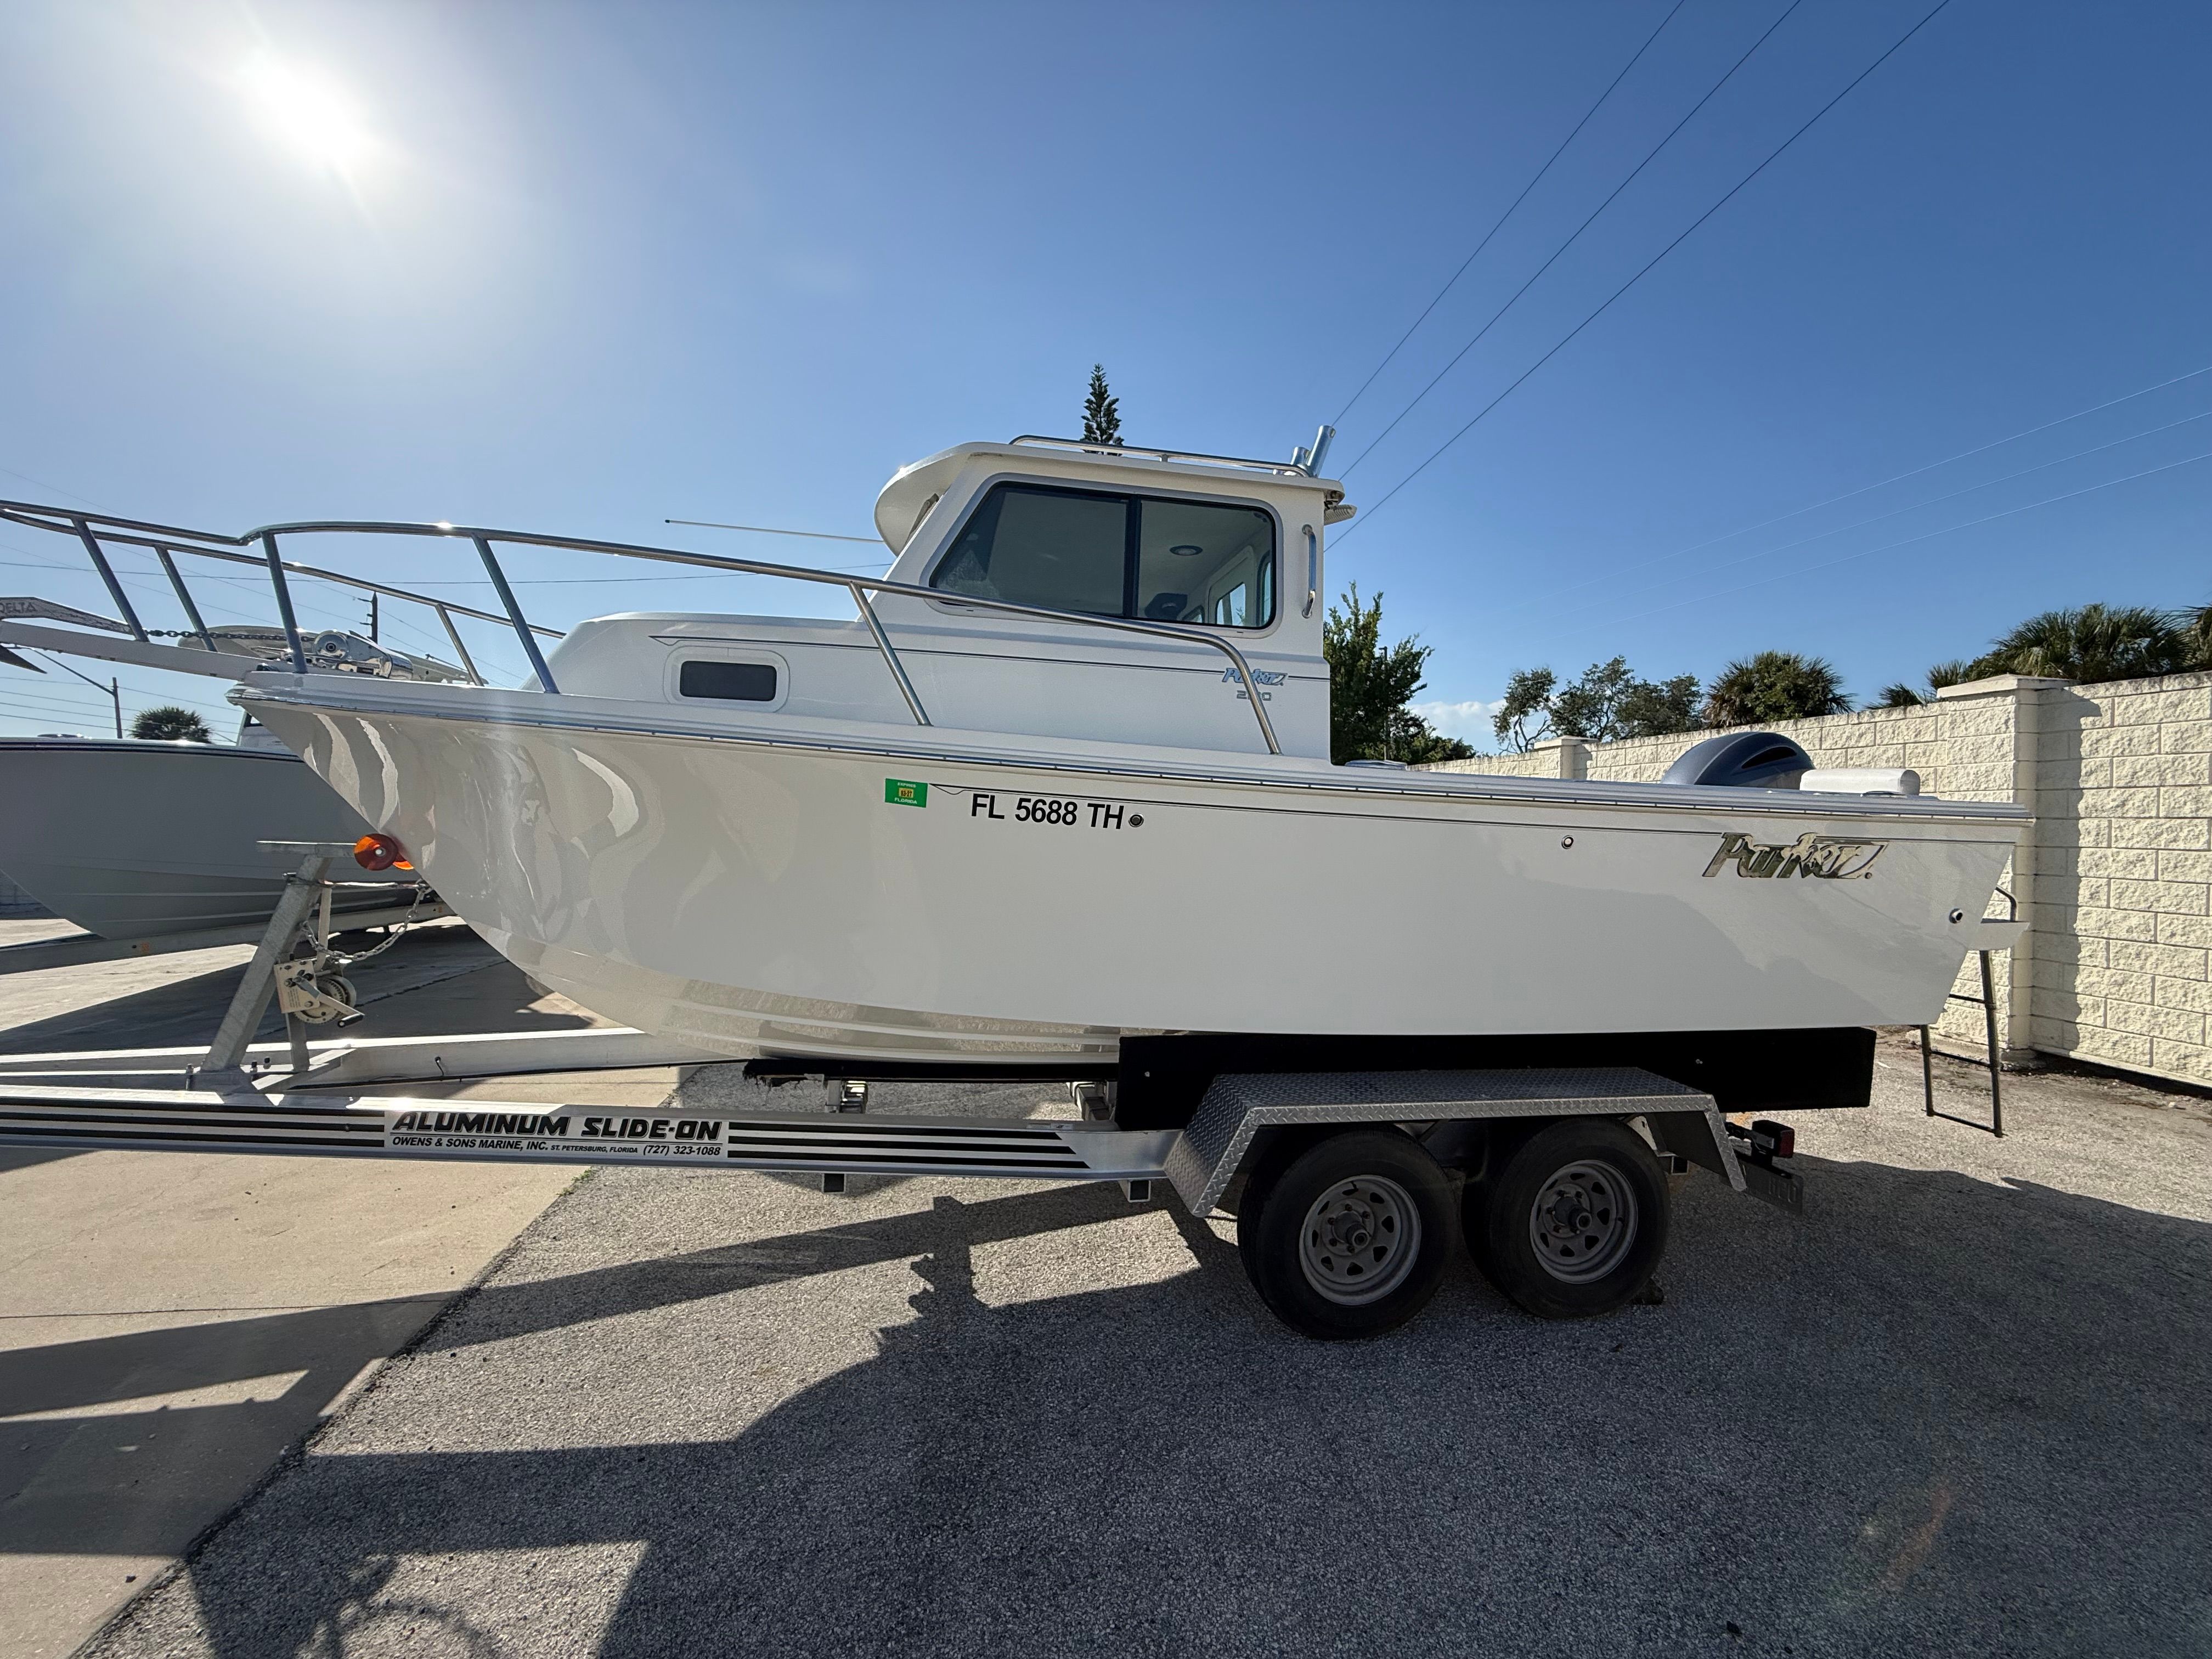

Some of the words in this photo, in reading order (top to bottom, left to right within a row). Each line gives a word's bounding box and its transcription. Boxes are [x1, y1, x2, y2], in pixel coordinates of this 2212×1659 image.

[1222, 668, 1288, 686] Paker
[1237, 690, 1272, 701] 20
[971, 793, 1005, 819] FL
[1015, 798, 1077, 825] 5688
[1087, 803, 1124, 829] TH
[1702, 832, 1889, 879] Parker
[392, 1112, 571, 1136] ALUMINUM
[581, 1117, 723, 1141] SLIDE-ON
[392, 1136, 432, 1147] OWENS
[435, 1137, 443, 1147] &
[445, 1138, 476, 1148] SONS
[478, 1139, 523, 1151] MARINE,
[526, 1141, 548, 1150] INC.
[643, 1144, 670, 1156] (727)
[673, 1146, 721, 1156] 323-1088
